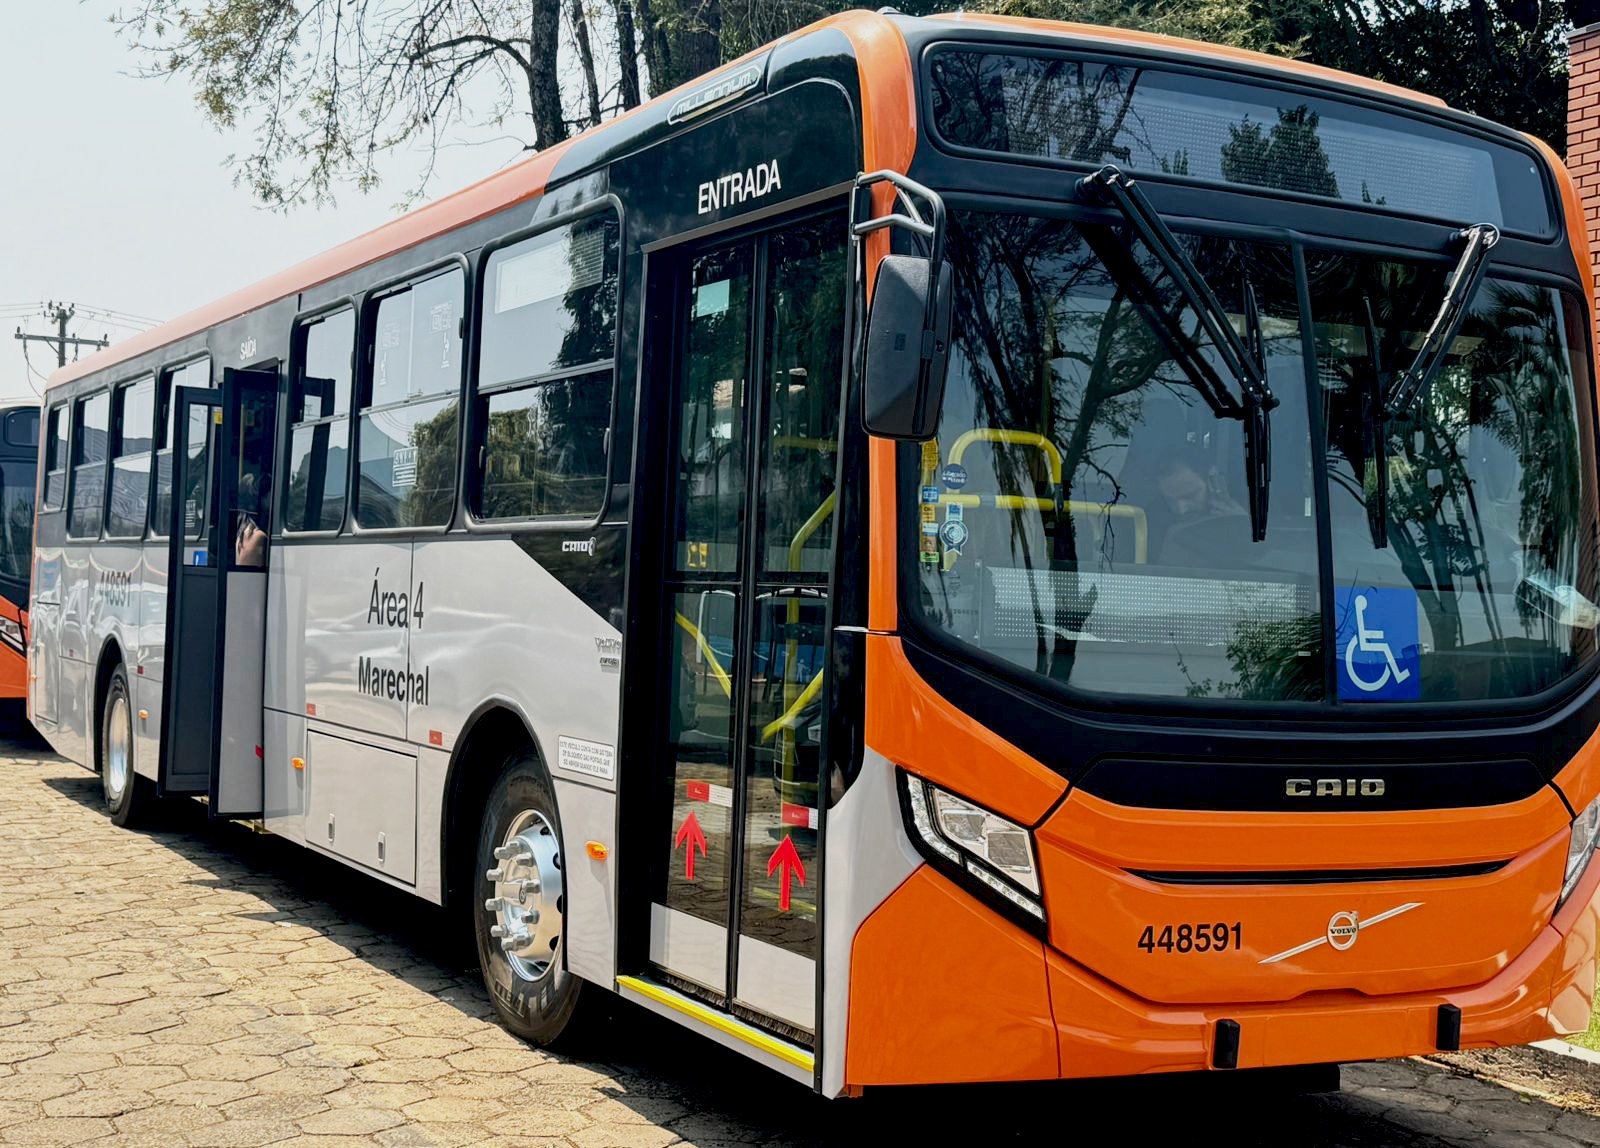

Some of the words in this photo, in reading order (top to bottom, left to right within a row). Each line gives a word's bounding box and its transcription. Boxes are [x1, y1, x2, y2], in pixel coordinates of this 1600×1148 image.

[698, 159, 782, 215] ENTRADA
[562, 541, 589, 552] CAIO
[367, 567, 409, 628] Área
[413, 581, 424, 629] 4
[358, 655, 429, 706] Marechal
[1285, 778, 1386, 796] CAIO
[1137, 922, 1242, 953] 448591
[1330, 927, 1357, 935] VOLVO
